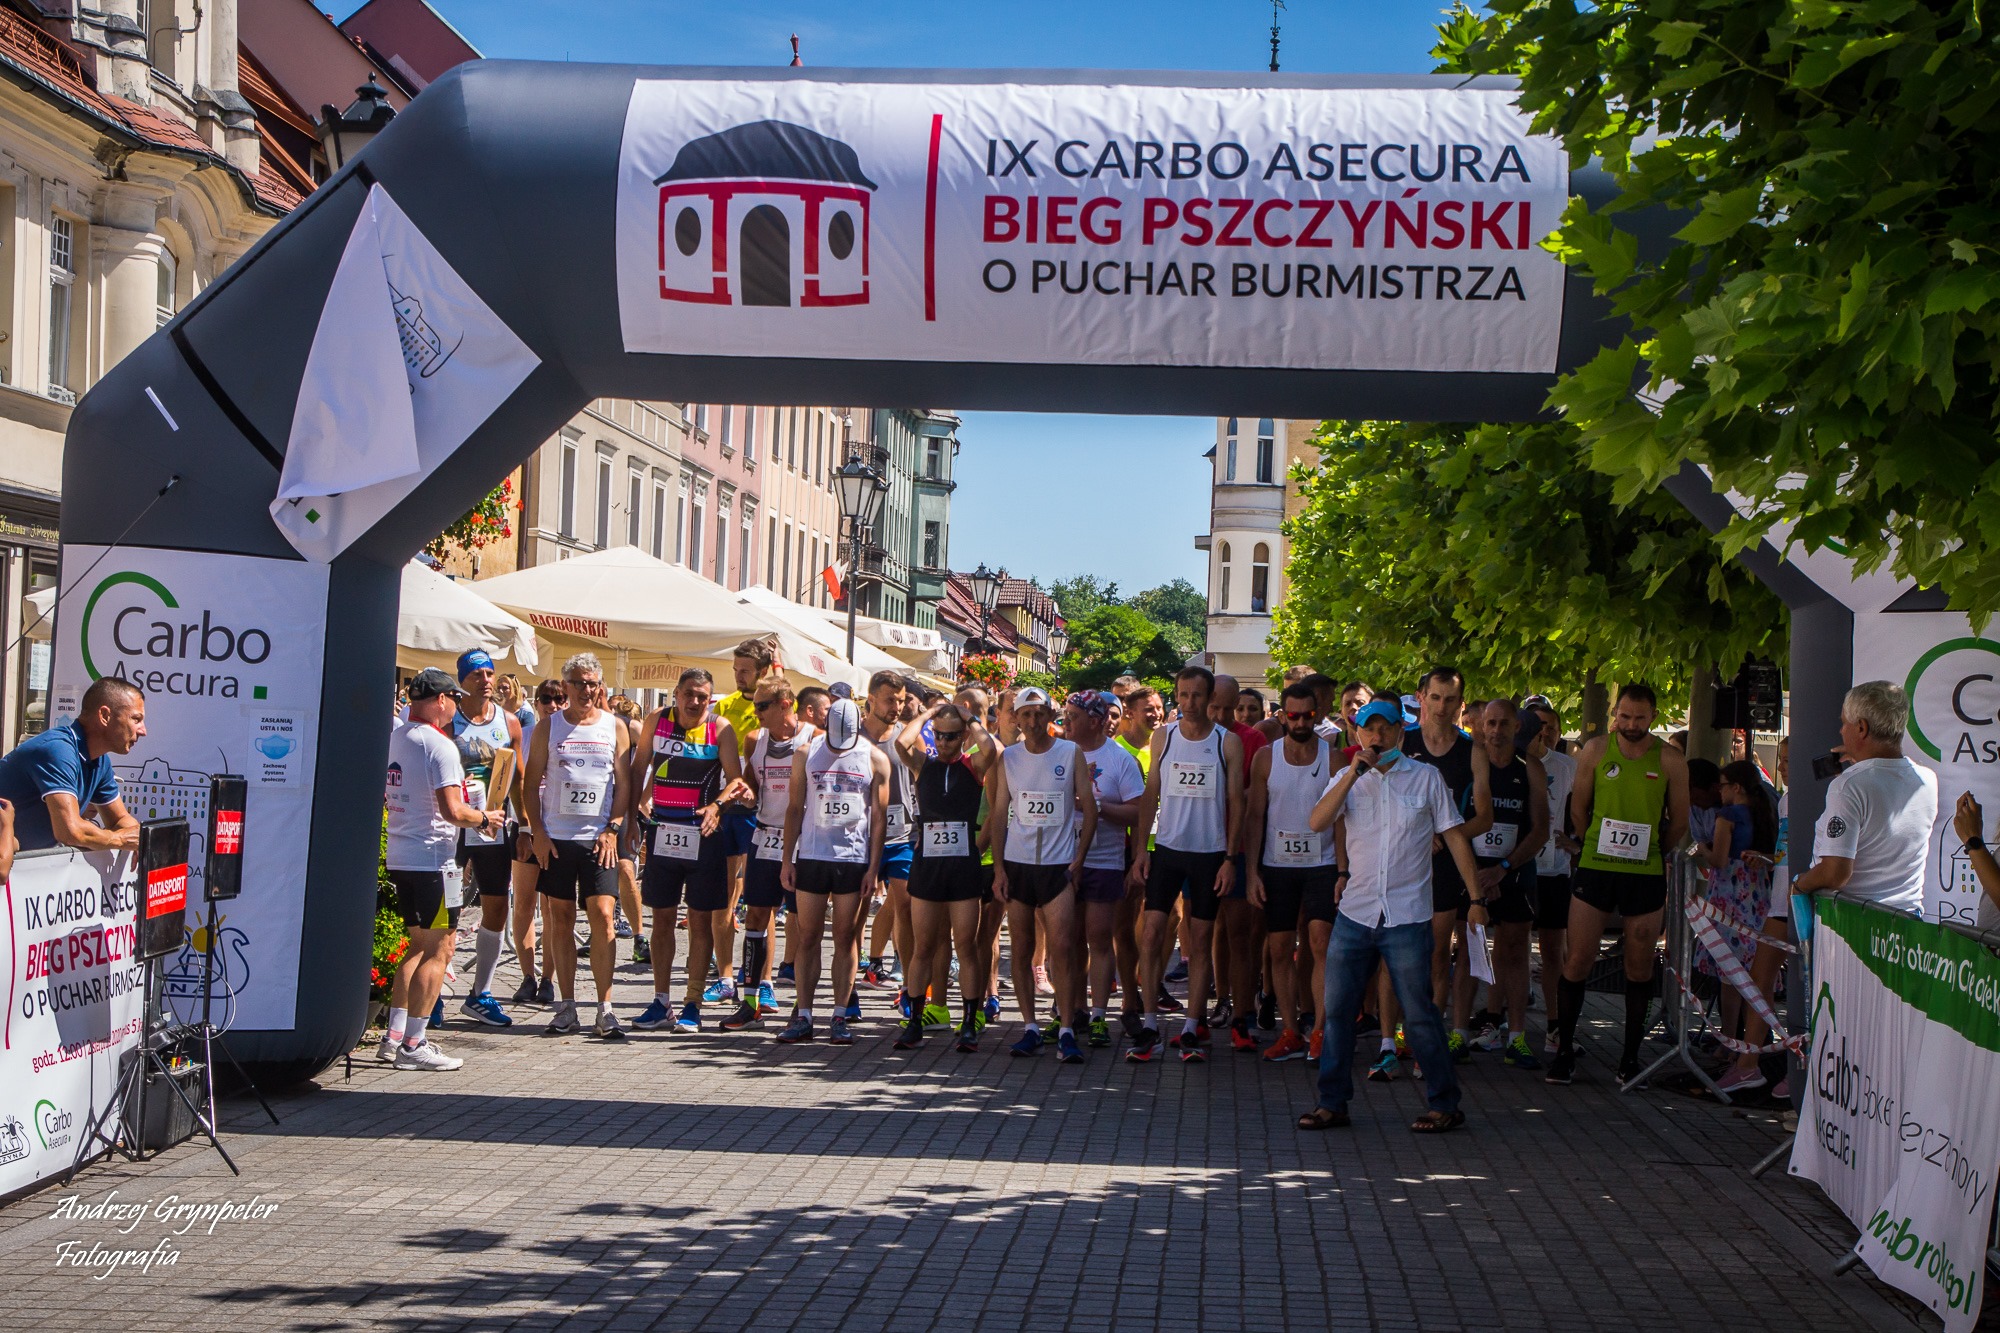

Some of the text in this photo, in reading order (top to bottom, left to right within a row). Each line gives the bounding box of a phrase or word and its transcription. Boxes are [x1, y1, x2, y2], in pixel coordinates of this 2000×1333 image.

[986, 139, 1532, 184] IX CARBO ASECURA
[983, 187, 1531, 250] BIEG PSZCZYŃSKI
[982, 258, 1526, 301] O PUCHAR BURMISTRZA
[113, 606, 272, 665] Carbo
[529, 613, 609, 639] RACIBORSKIE
[113, 661, 239, 699] Asecura
[1952, 673, 2000, 726] C
[261, 717, 293, 725] ZASŁANIAJ
[1952, 732, 2000, 764] As
[1179, 772, 1206, 786] 222
[570, 791, 596, 804] 229
[824, 802, 850, 815] 159
[1027, 801, 1055, 814] 220
[217, 821, 243, 836] DATASPORT
[664, 833, 689, 848] 131
[933, 832, 959, 845] 233
[1484, 832, 1503, 846] 86
[1610, 831, 1639, 847] 170
[1284, 840, 1311, 853] 151
[148, 875, 186, 899] DATASPORT
[25, 895, 43, 931] IX
[45, 886, 96, 926] CARBO
[25, 937, 65, 981] BIEG
[1888, 932, 1900, 964] 25
[23, 991, 35, 1019] O
[38, 978, 104, 1016] PUCHAR
[32, 1050, 58, 1074] godz.
[57, 1042, 82, 1063] 12:00
[131, 1018, 137, 1034] 5
[45, 1108, 72, 1134] Carbo
